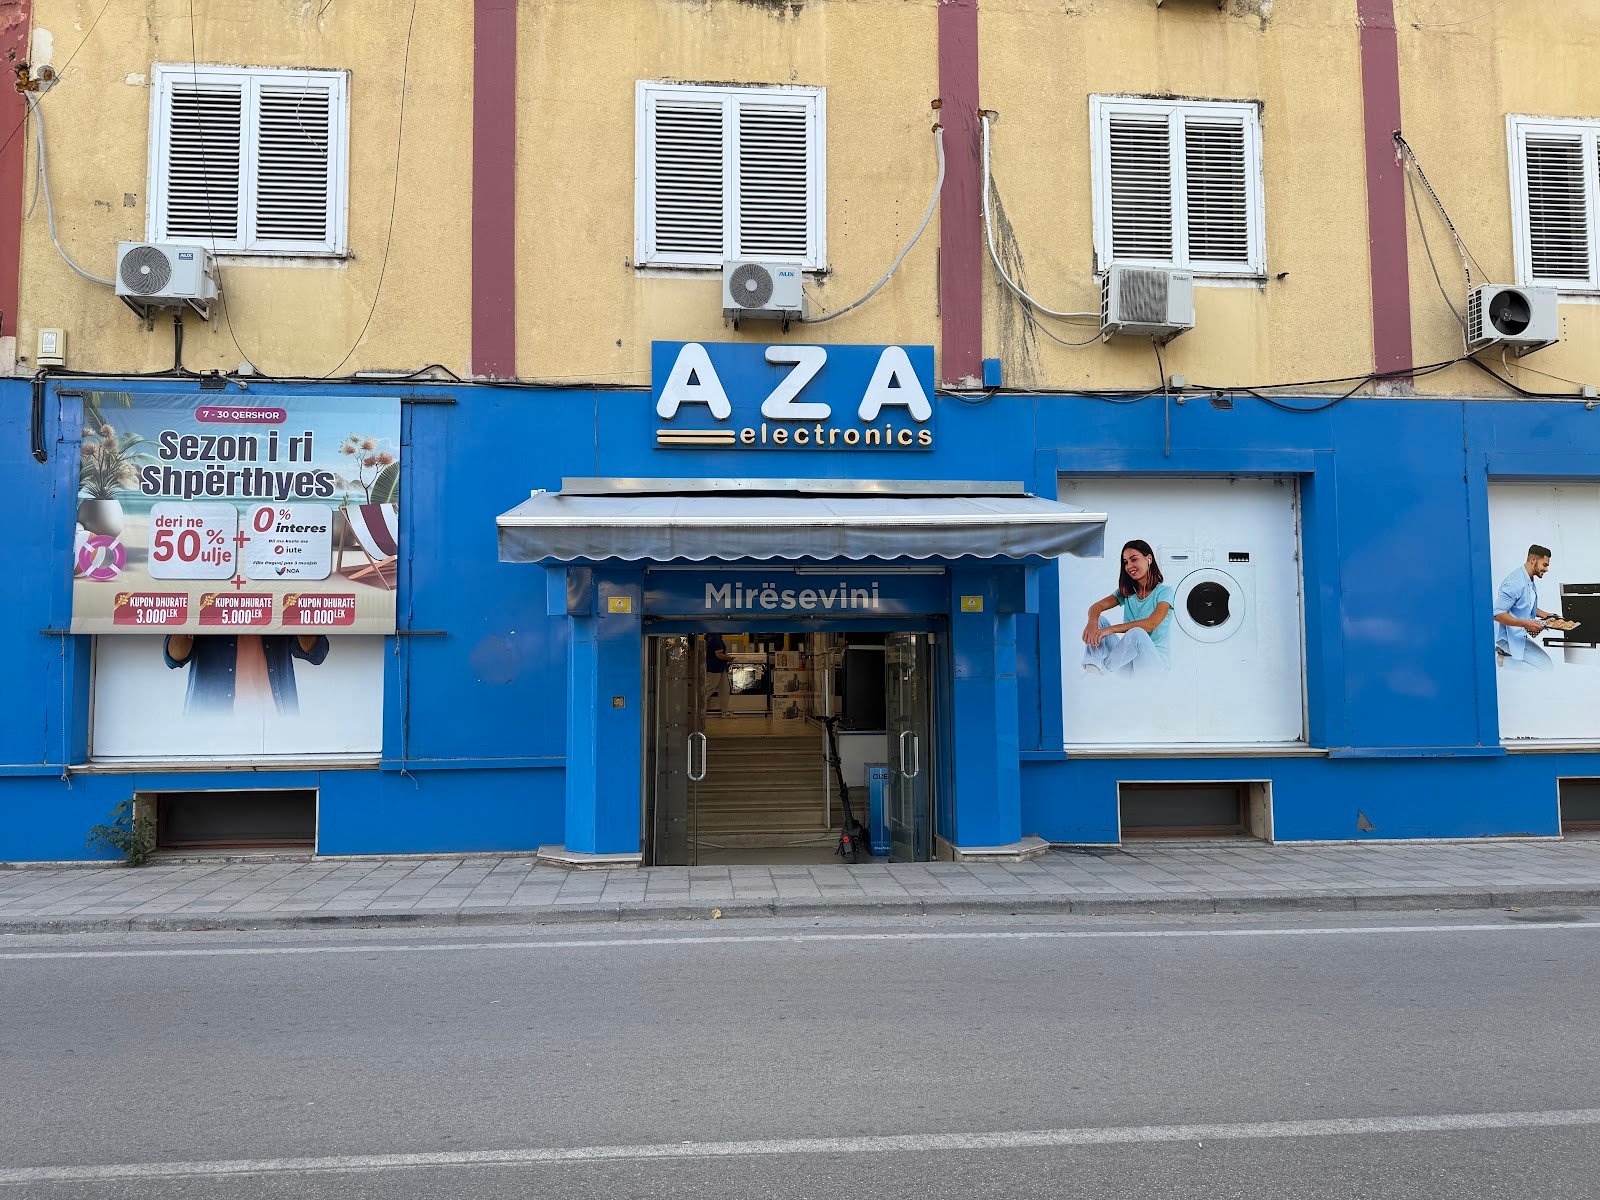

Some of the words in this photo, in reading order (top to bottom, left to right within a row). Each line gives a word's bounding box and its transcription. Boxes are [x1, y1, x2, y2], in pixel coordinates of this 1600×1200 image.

[656, 342, 932, 422] AZA
[202, 410, 209, 418] 7
[217, 410, 230, 419] 30
[231, 411, 280, 420] QERSHOR
[740, 422, 932, 445] electronics
[159, 430, 257, 462] Sezon
[268, 430, 278, 462] i
[289, 431, 313, 462] ri
[141, 464, 335, 501] Shpërthyes
[155, 514, 183, 528] deri
[186, 517, 204, 528] ne
[275, 522, 327, 533] interes
[201, 546, 232, 567] ulje
[286, 546, 302, 554] iute
[129, 596, 154, 607] KUPON
[155, 596, 188, 607] DHURATE
[215, 597, 238, 608] KUPON
[240, 597, 272, 608] DHURATE
[297, 597, 321, 608] KUPON
[323, 597, 355, 608] DHURATE
[705, 581, 880, 610] Mirësevini
